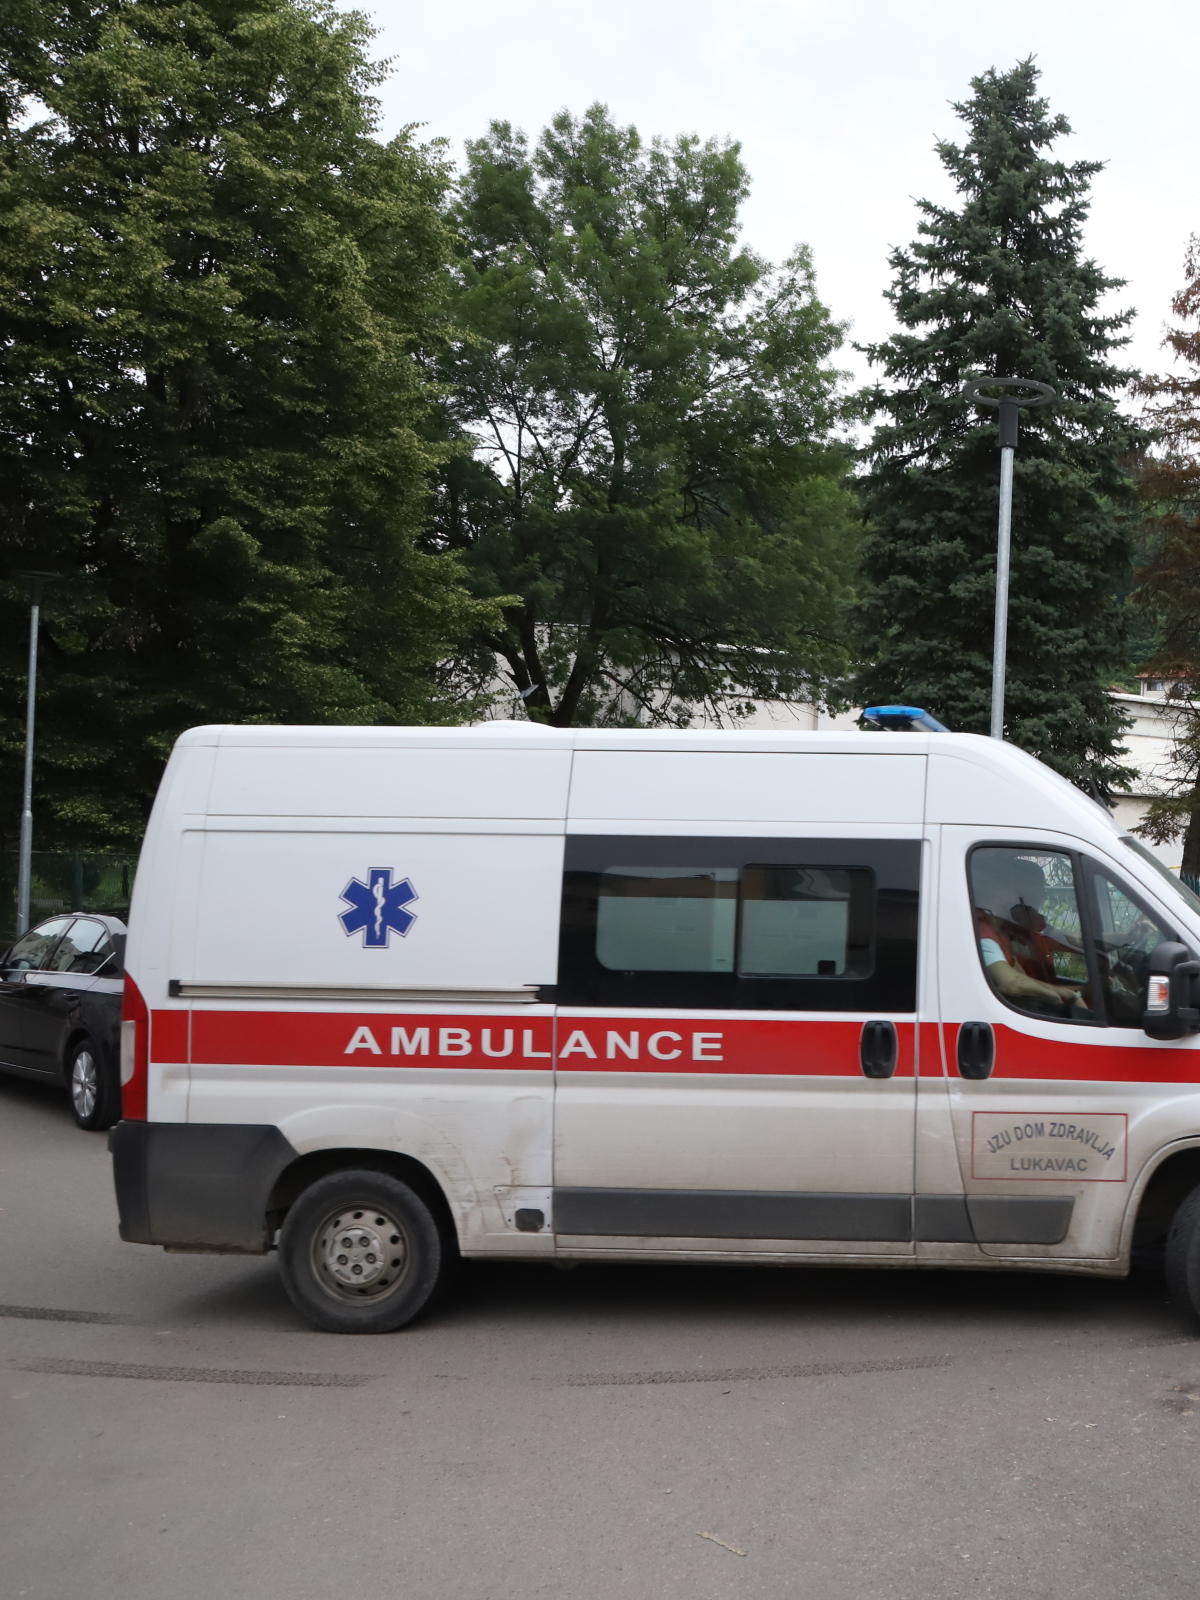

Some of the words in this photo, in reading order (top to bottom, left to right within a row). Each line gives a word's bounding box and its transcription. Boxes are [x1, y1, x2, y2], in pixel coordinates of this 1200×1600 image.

[343, 1026, 724, 1061] AMBULANCE
[986, 1130, 1012, 1154] JZU
[1014, 1122, 1045, 1141] DOM
[1049, 1122, 1115, 1161] ZDRAVLJA
[1010, 1158, 1088, 1171] LUKAVAC
